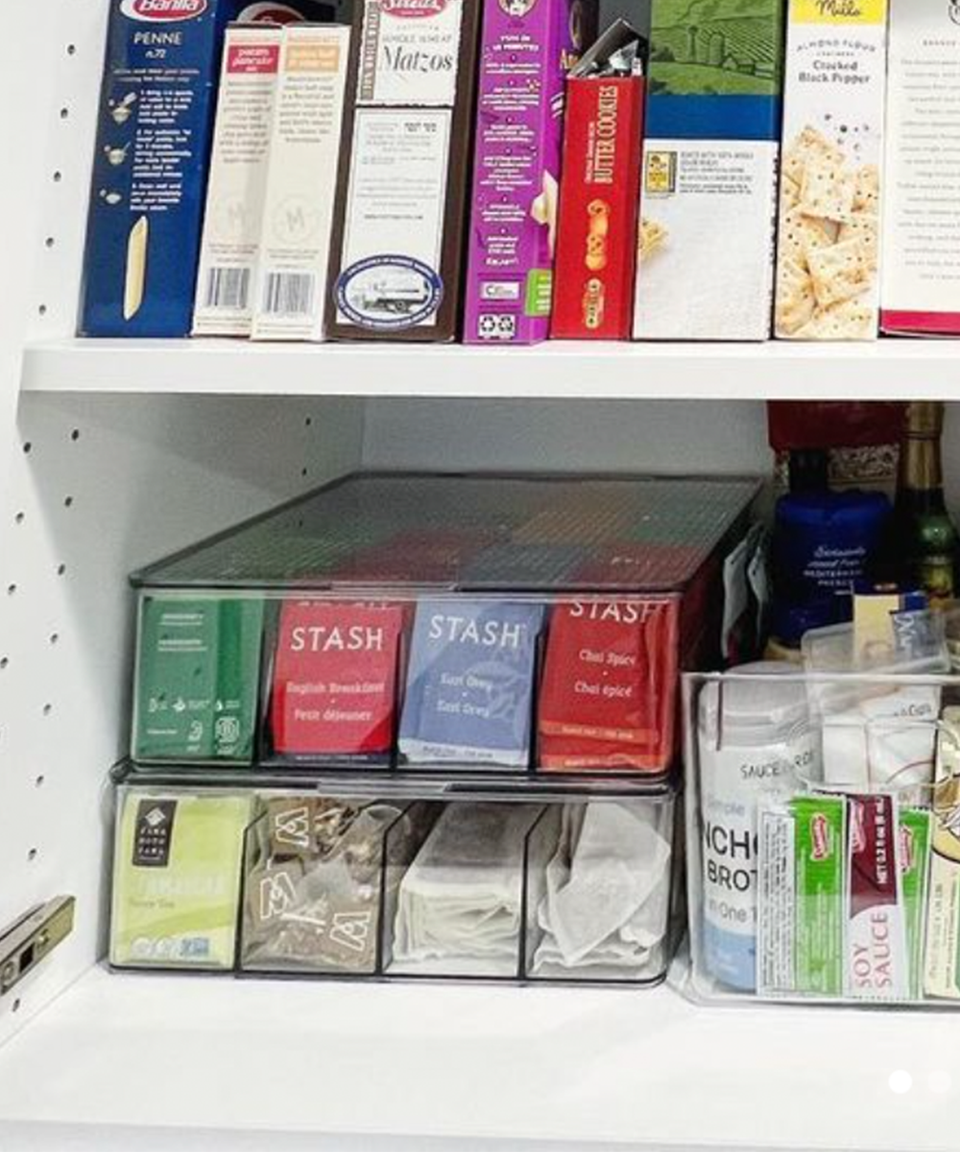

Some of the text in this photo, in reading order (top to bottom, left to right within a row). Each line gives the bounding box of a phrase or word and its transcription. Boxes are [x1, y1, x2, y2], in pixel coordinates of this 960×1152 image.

[133, 31, 183, 45] PENNE
[383, 45, 453, 73] Matzos
[812, 60, 858, 71] Cracked
[798, 72, 870, 85] Black Pepper
[594, 85, 618, 184] BUTTER COOKIES
[290, 625, 383, 652] STASH
[428, 614, 521, 649] STASH
[740, 762, 781, 779] SAUCE
[719, 902, 747, 923] One
[871, 913, 892, 988] SAUCE
[853, 943, 872, 988] SOY
